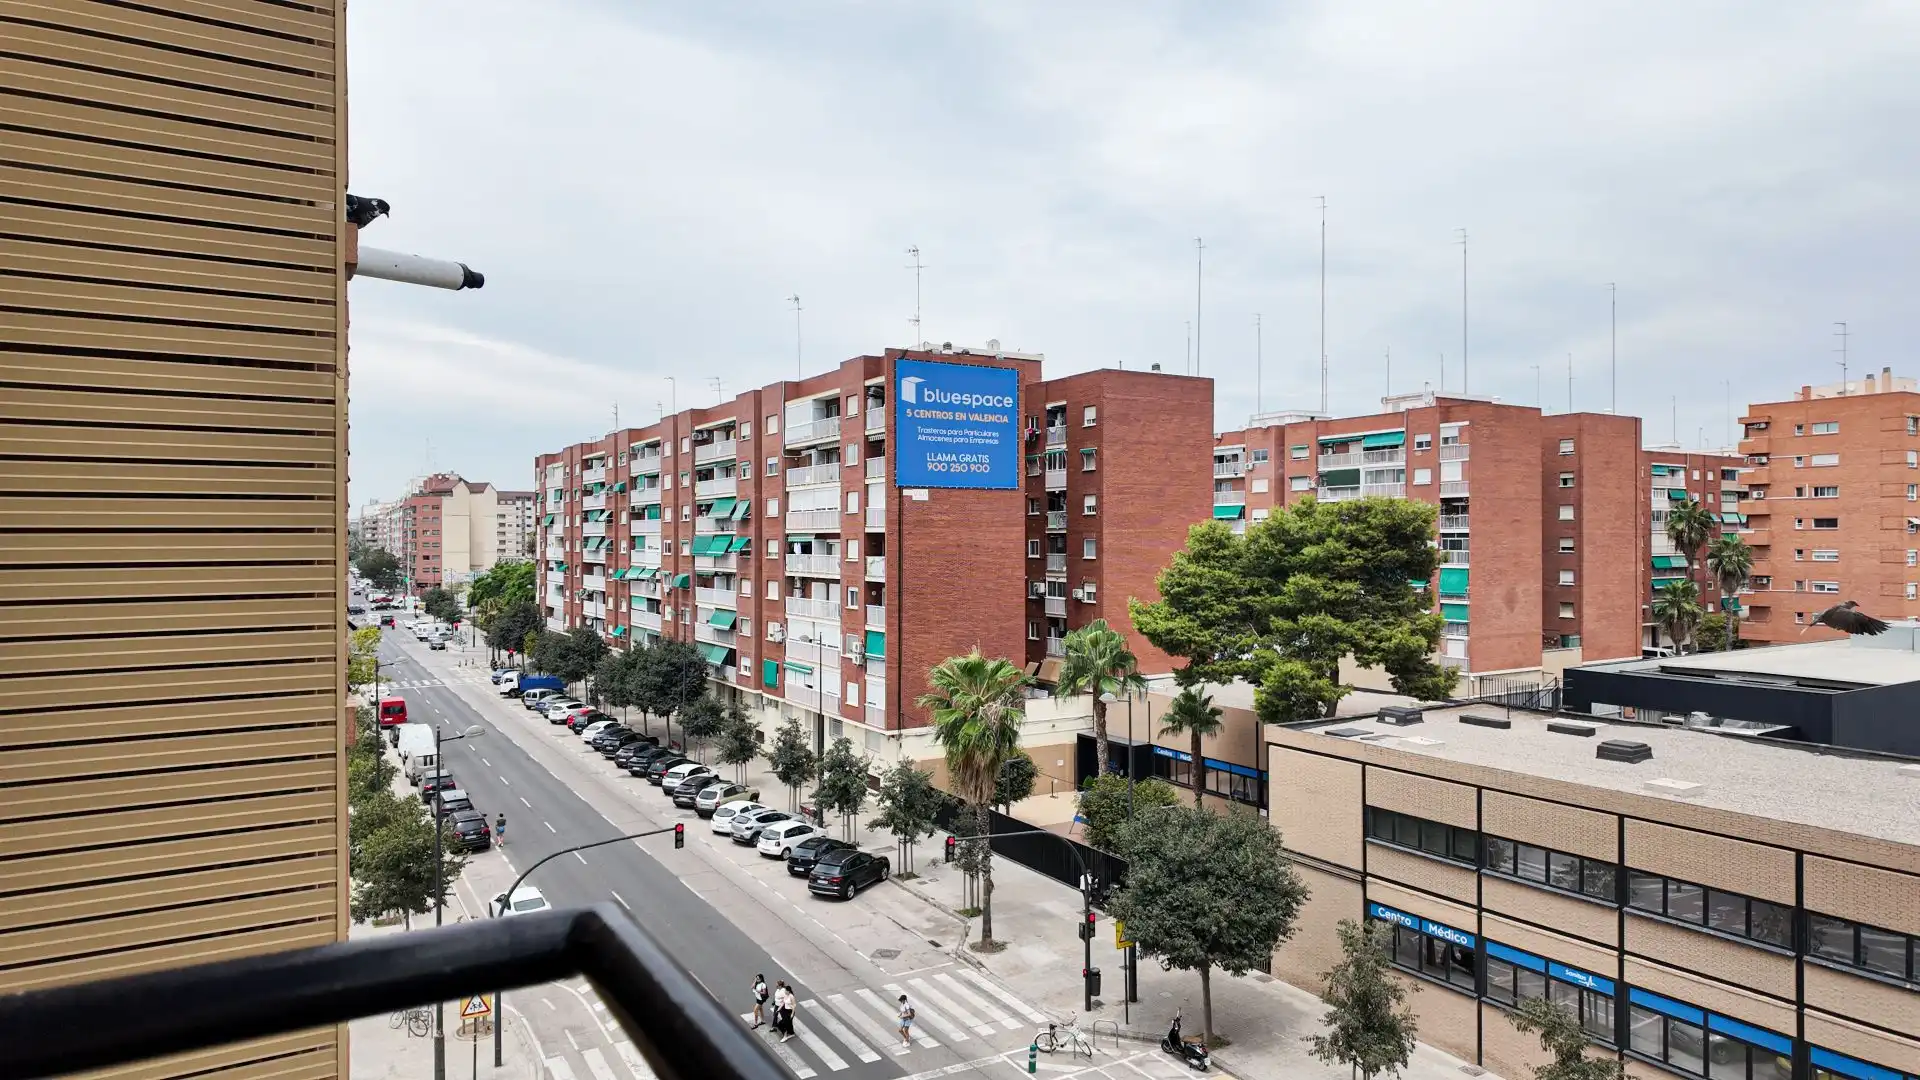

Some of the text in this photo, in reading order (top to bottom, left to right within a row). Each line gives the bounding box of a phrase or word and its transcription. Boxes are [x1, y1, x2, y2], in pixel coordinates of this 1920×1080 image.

[924, 387, 1013, 408] bluespace
[906, 408, 1009, 423] 5 CENTROS EN VALENCIA
[917, 426, 999, 438] Trasteros para Particulares
[917, 435, 999, 445] Almacenes para Empresas
[926, 452, 990, 463] LLAMA GRATIS
[927, 462, 990, 473] 900 250 900
[1378, 907, 1468, 945] Centro Médico
